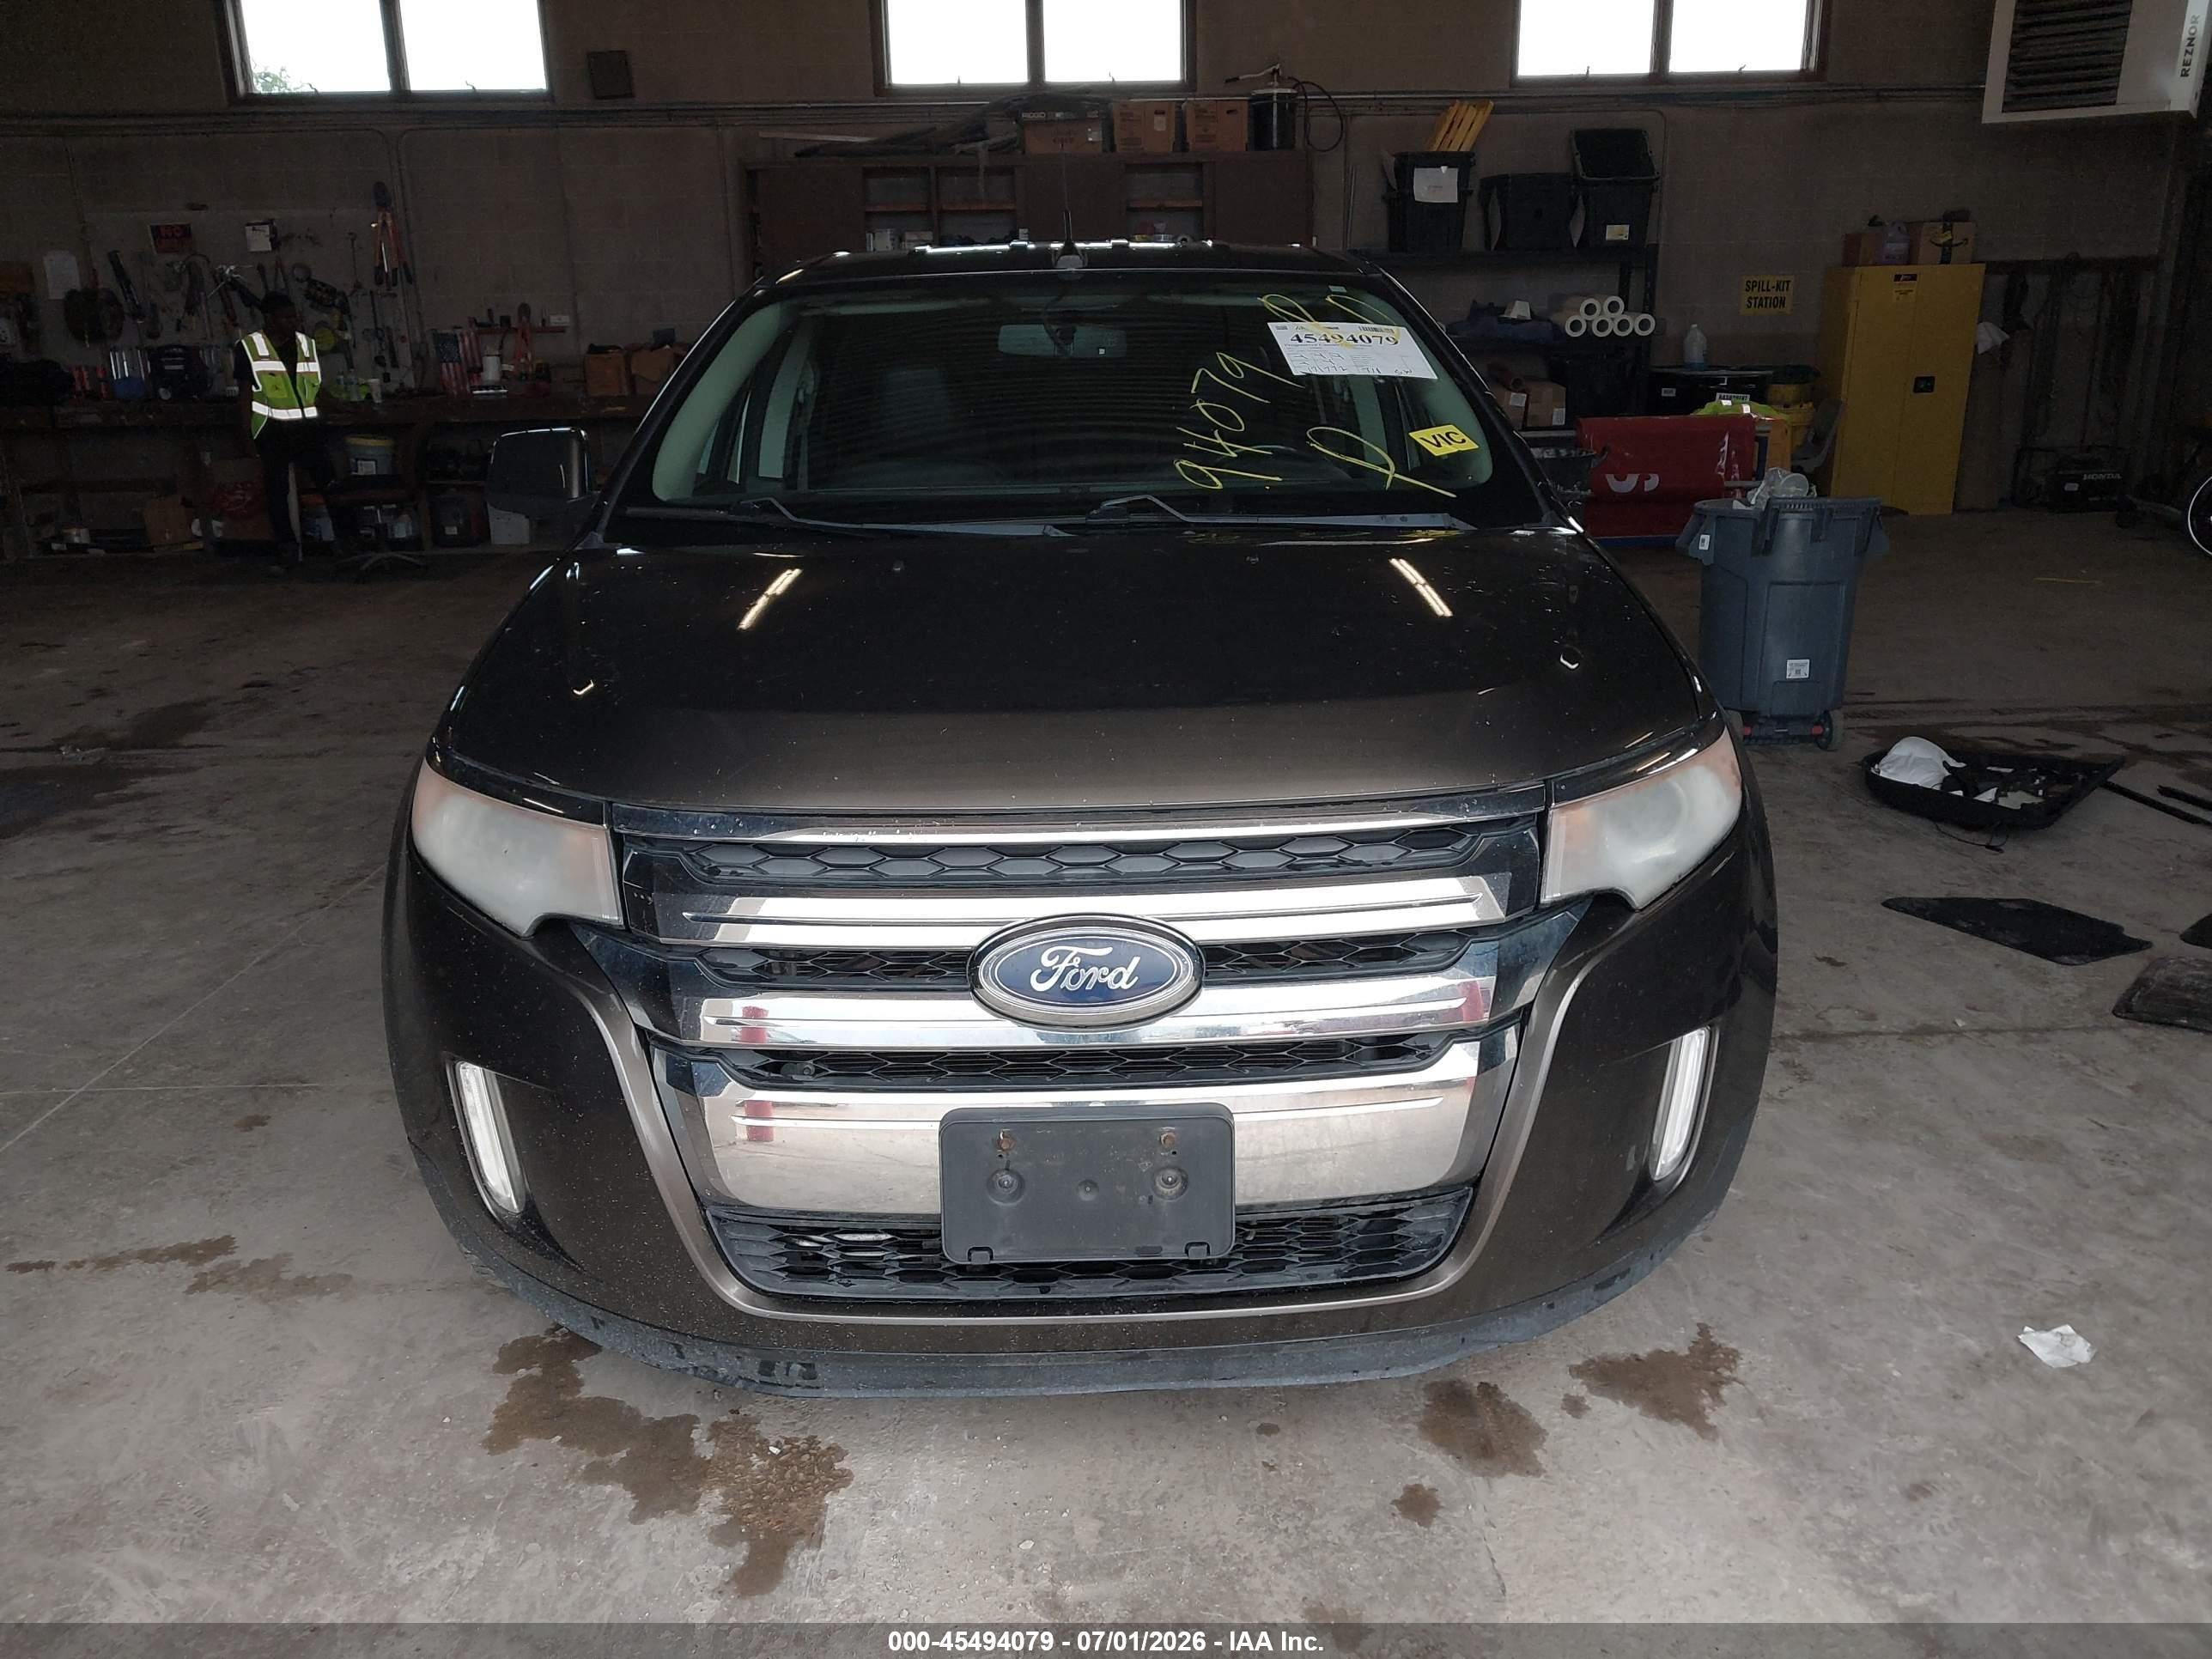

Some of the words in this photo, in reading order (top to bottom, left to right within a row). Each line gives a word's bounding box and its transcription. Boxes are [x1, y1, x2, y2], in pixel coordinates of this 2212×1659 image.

[2180, 15, 2201, 77] REZNOR
[1745, 280, 1791, 292] SPILL-KIT
[1747, 296, 1786, 309] STATION
[1291, 333, 1400, 346] 45494079
[1419, 430, 1467, 448] VIC
[1030, 945, 1141, 992] Ford
